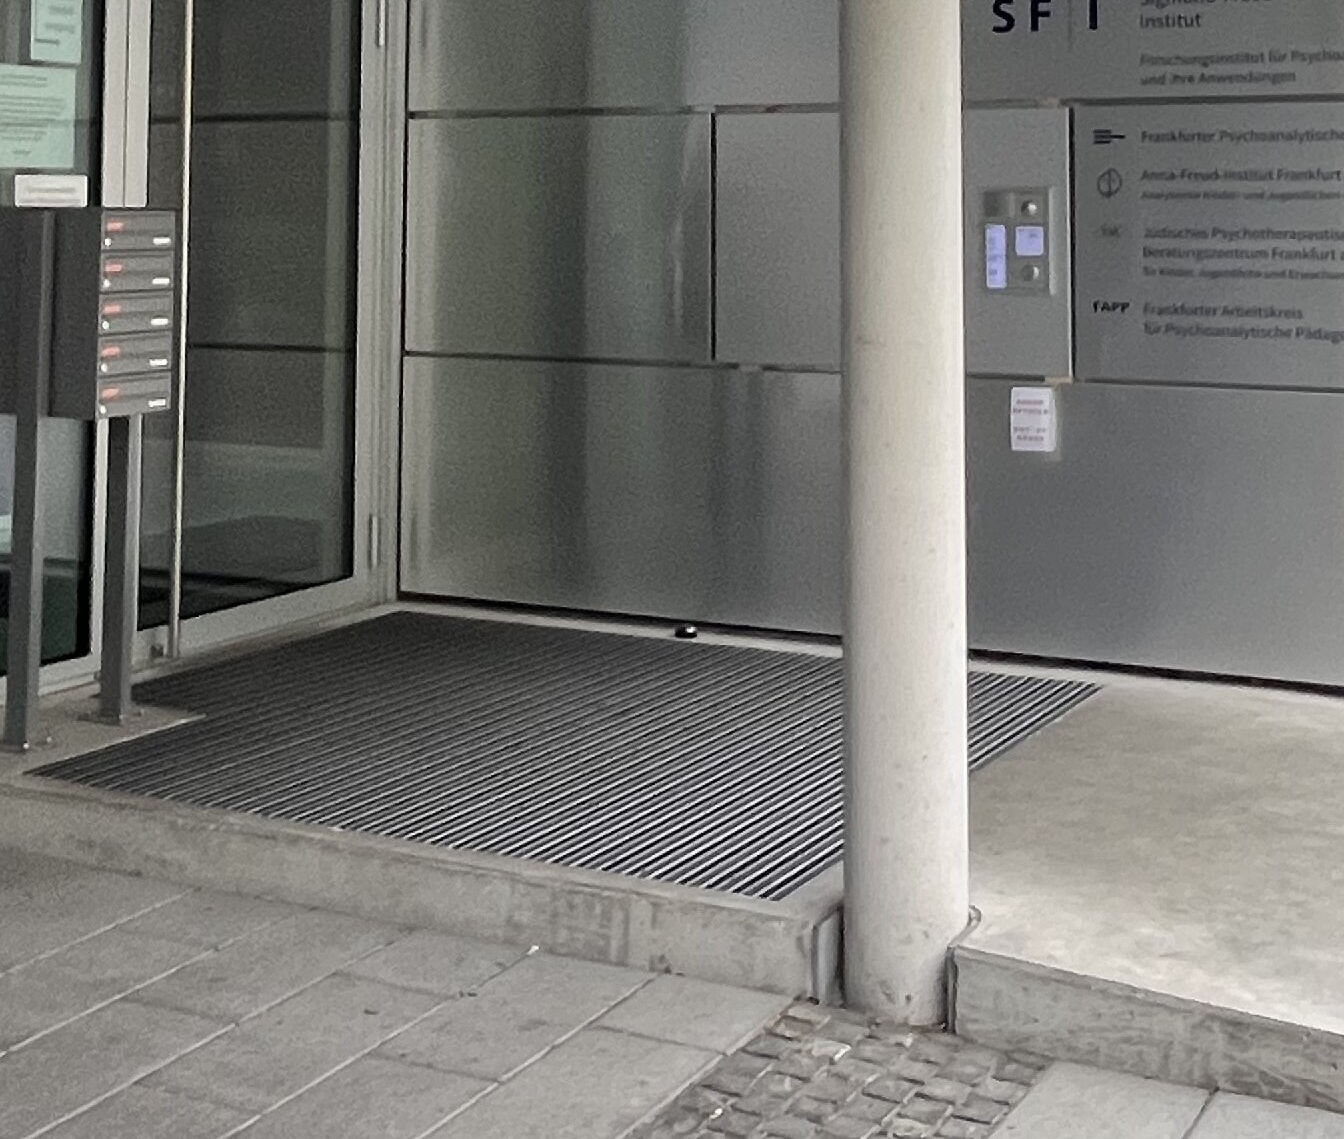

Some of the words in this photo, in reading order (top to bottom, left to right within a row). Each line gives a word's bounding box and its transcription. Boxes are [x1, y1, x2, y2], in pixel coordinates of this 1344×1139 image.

[1139, 13, 1202, 29] Institut
[1140, 72, 1167, 86] und
[1277, 166, 1342, 182] Frankfurt
[1271, 247, 1336, 262] Frankfurt
